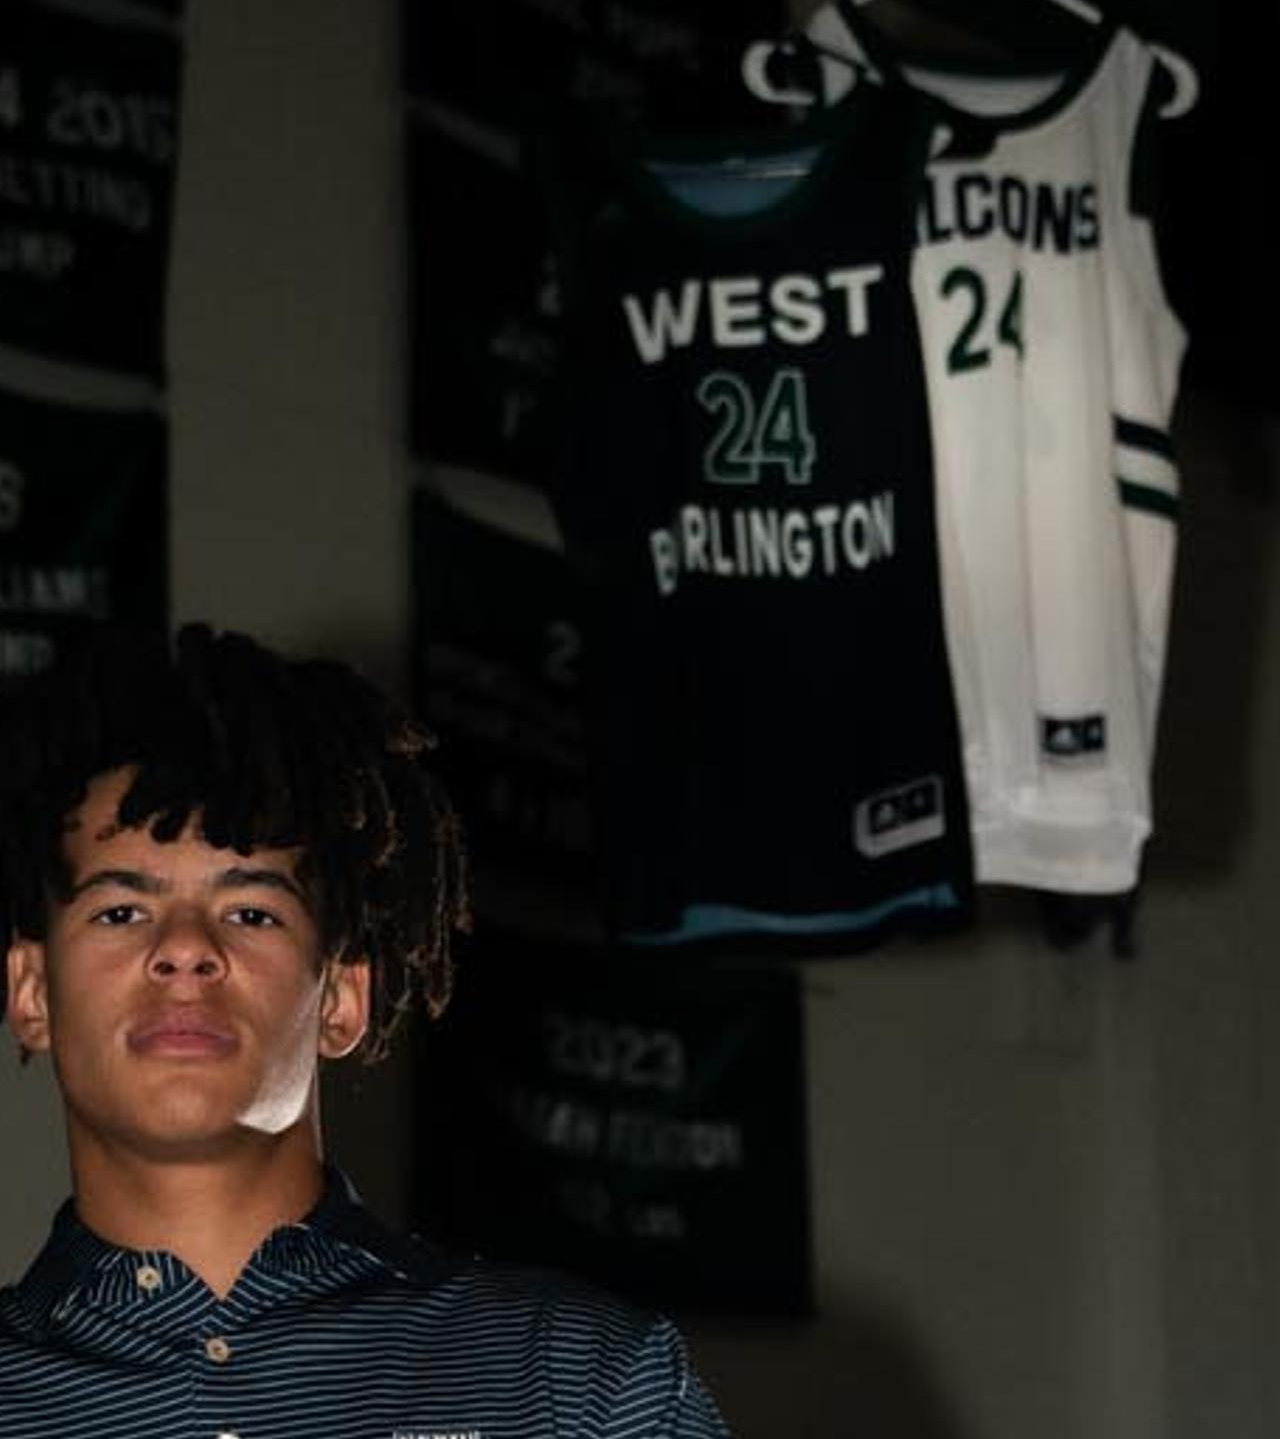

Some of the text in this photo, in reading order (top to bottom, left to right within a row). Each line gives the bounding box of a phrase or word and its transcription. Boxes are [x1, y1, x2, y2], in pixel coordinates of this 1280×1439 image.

[622, 263, 886, 367] WEST
[696, 366, 817, 486] 24
[648, 491, 896, 597] BRLINGTON
